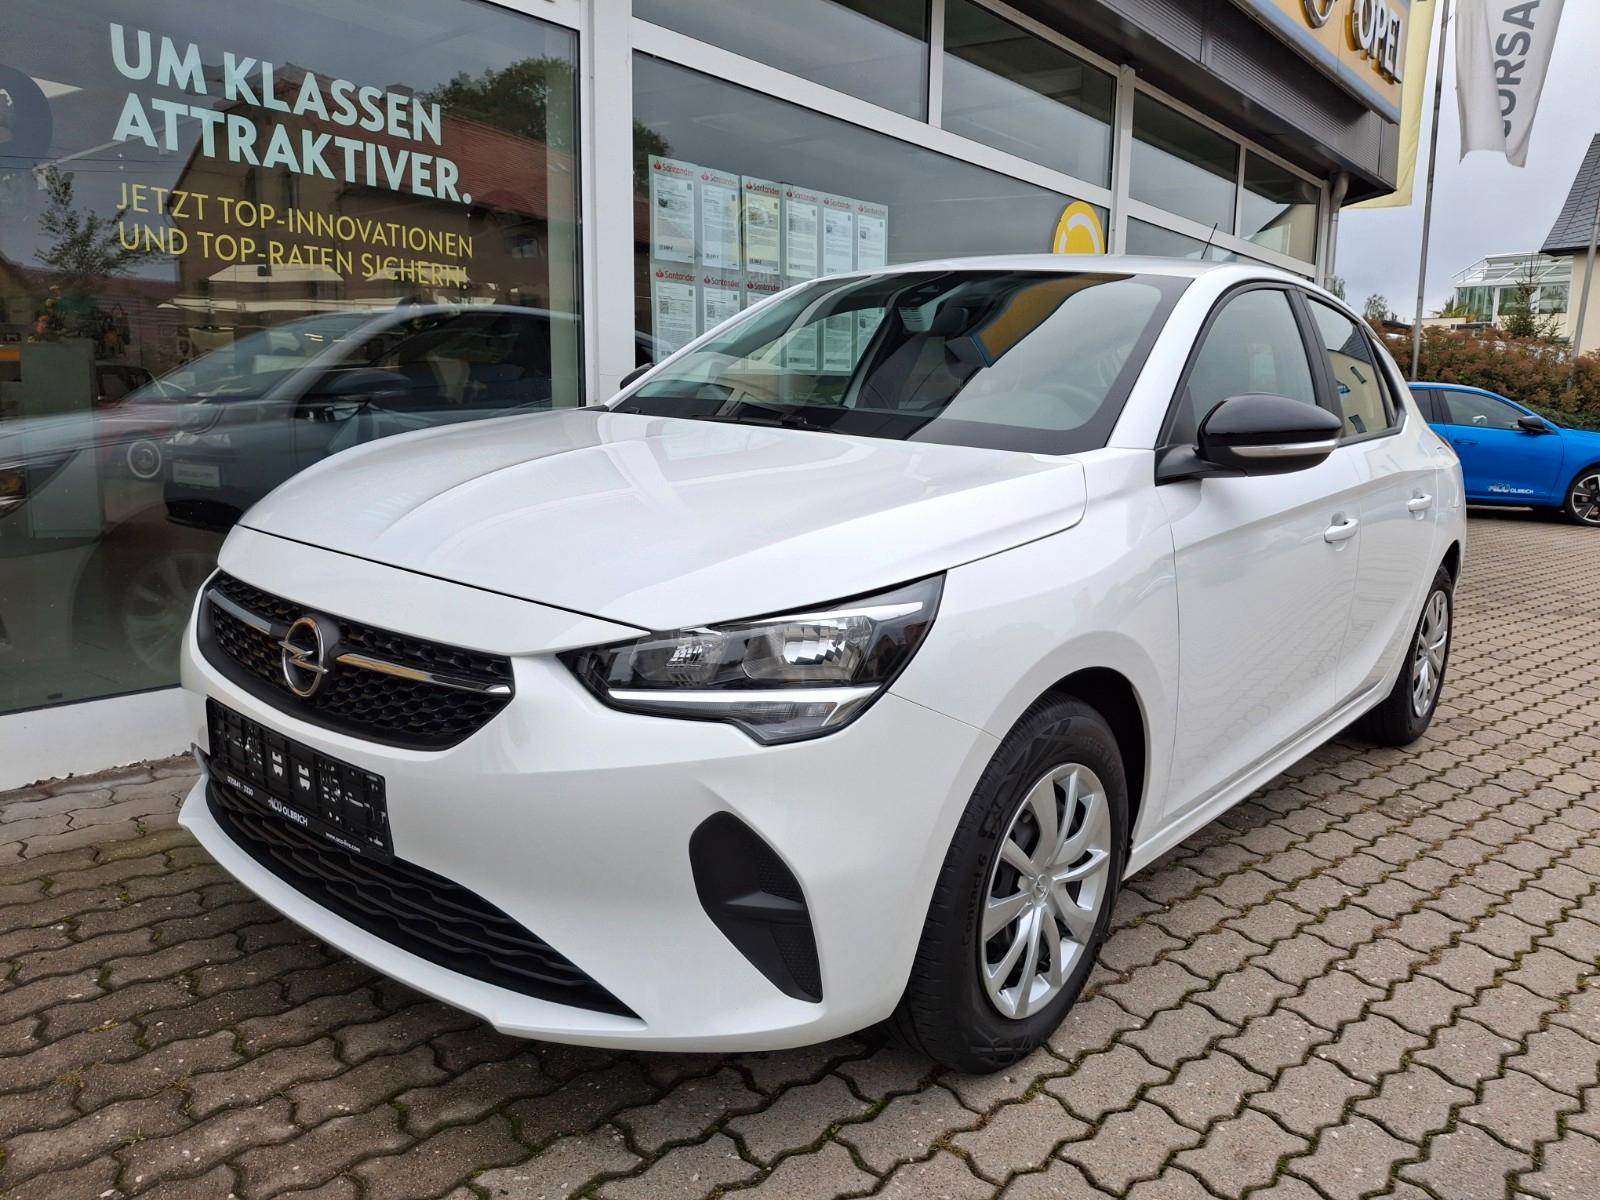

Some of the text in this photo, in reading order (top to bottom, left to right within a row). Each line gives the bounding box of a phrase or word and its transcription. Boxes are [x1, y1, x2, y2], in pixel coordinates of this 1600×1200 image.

[1353, 0, 1403, 83] OPEL
[110, 23, 442, 146] UM KLASSEN
[112, 92, 472, 205] ATTRAKTIVER.
[752, 182, 780, 196] Santander
[116, 182, 472, 258] JETZT TOP-INNOVATIONEN
[119, 221, 467, 290] UND TOP-RATEN SICHERN!
[664, 270, 696, 282] Santander
[710, 276, 740, 289] Santander
[753, 281, 781, 293] Santander
[283, 807, 308, 827] OLBRICH
